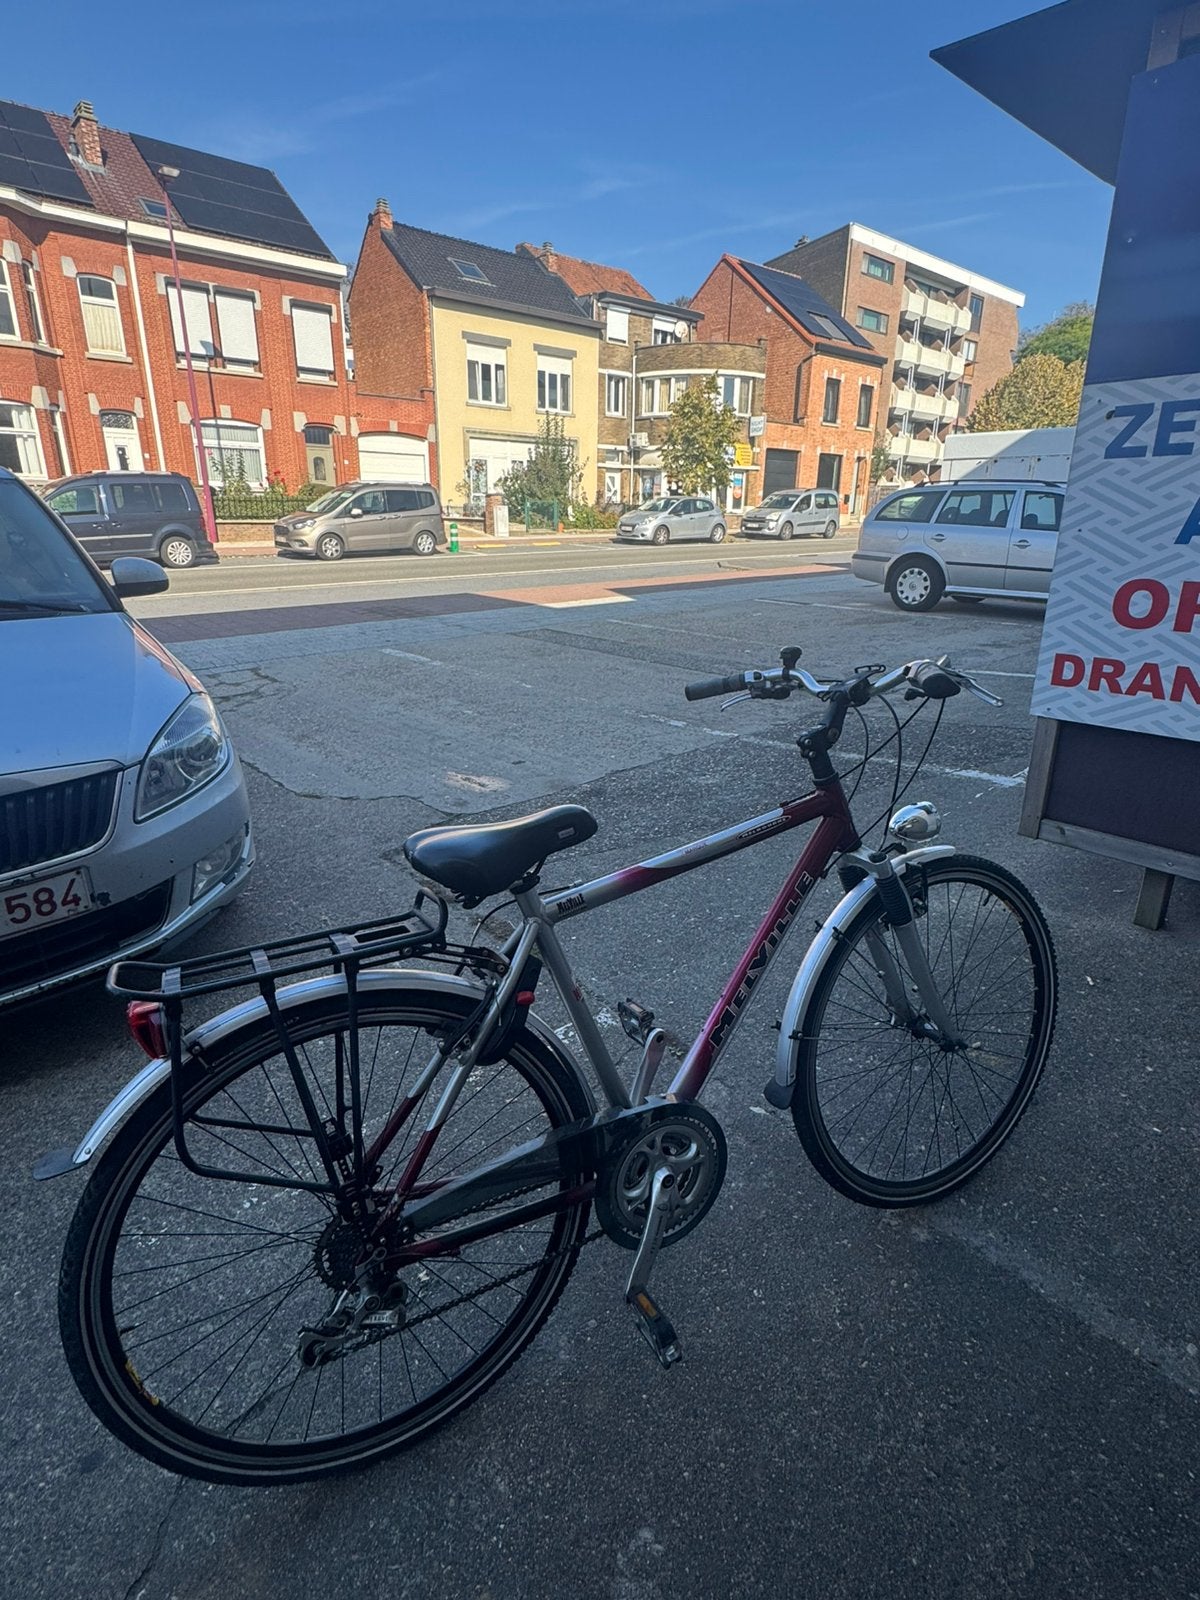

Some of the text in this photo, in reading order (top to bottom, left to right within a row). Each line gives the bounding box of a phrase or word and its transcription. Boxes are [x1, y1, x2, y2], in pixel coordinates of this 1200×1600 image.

[1104, 398, 1200, 459] ZE
[4, 877, 82, 924] 584
[709, 870, 814, 1049] MELVILLE
